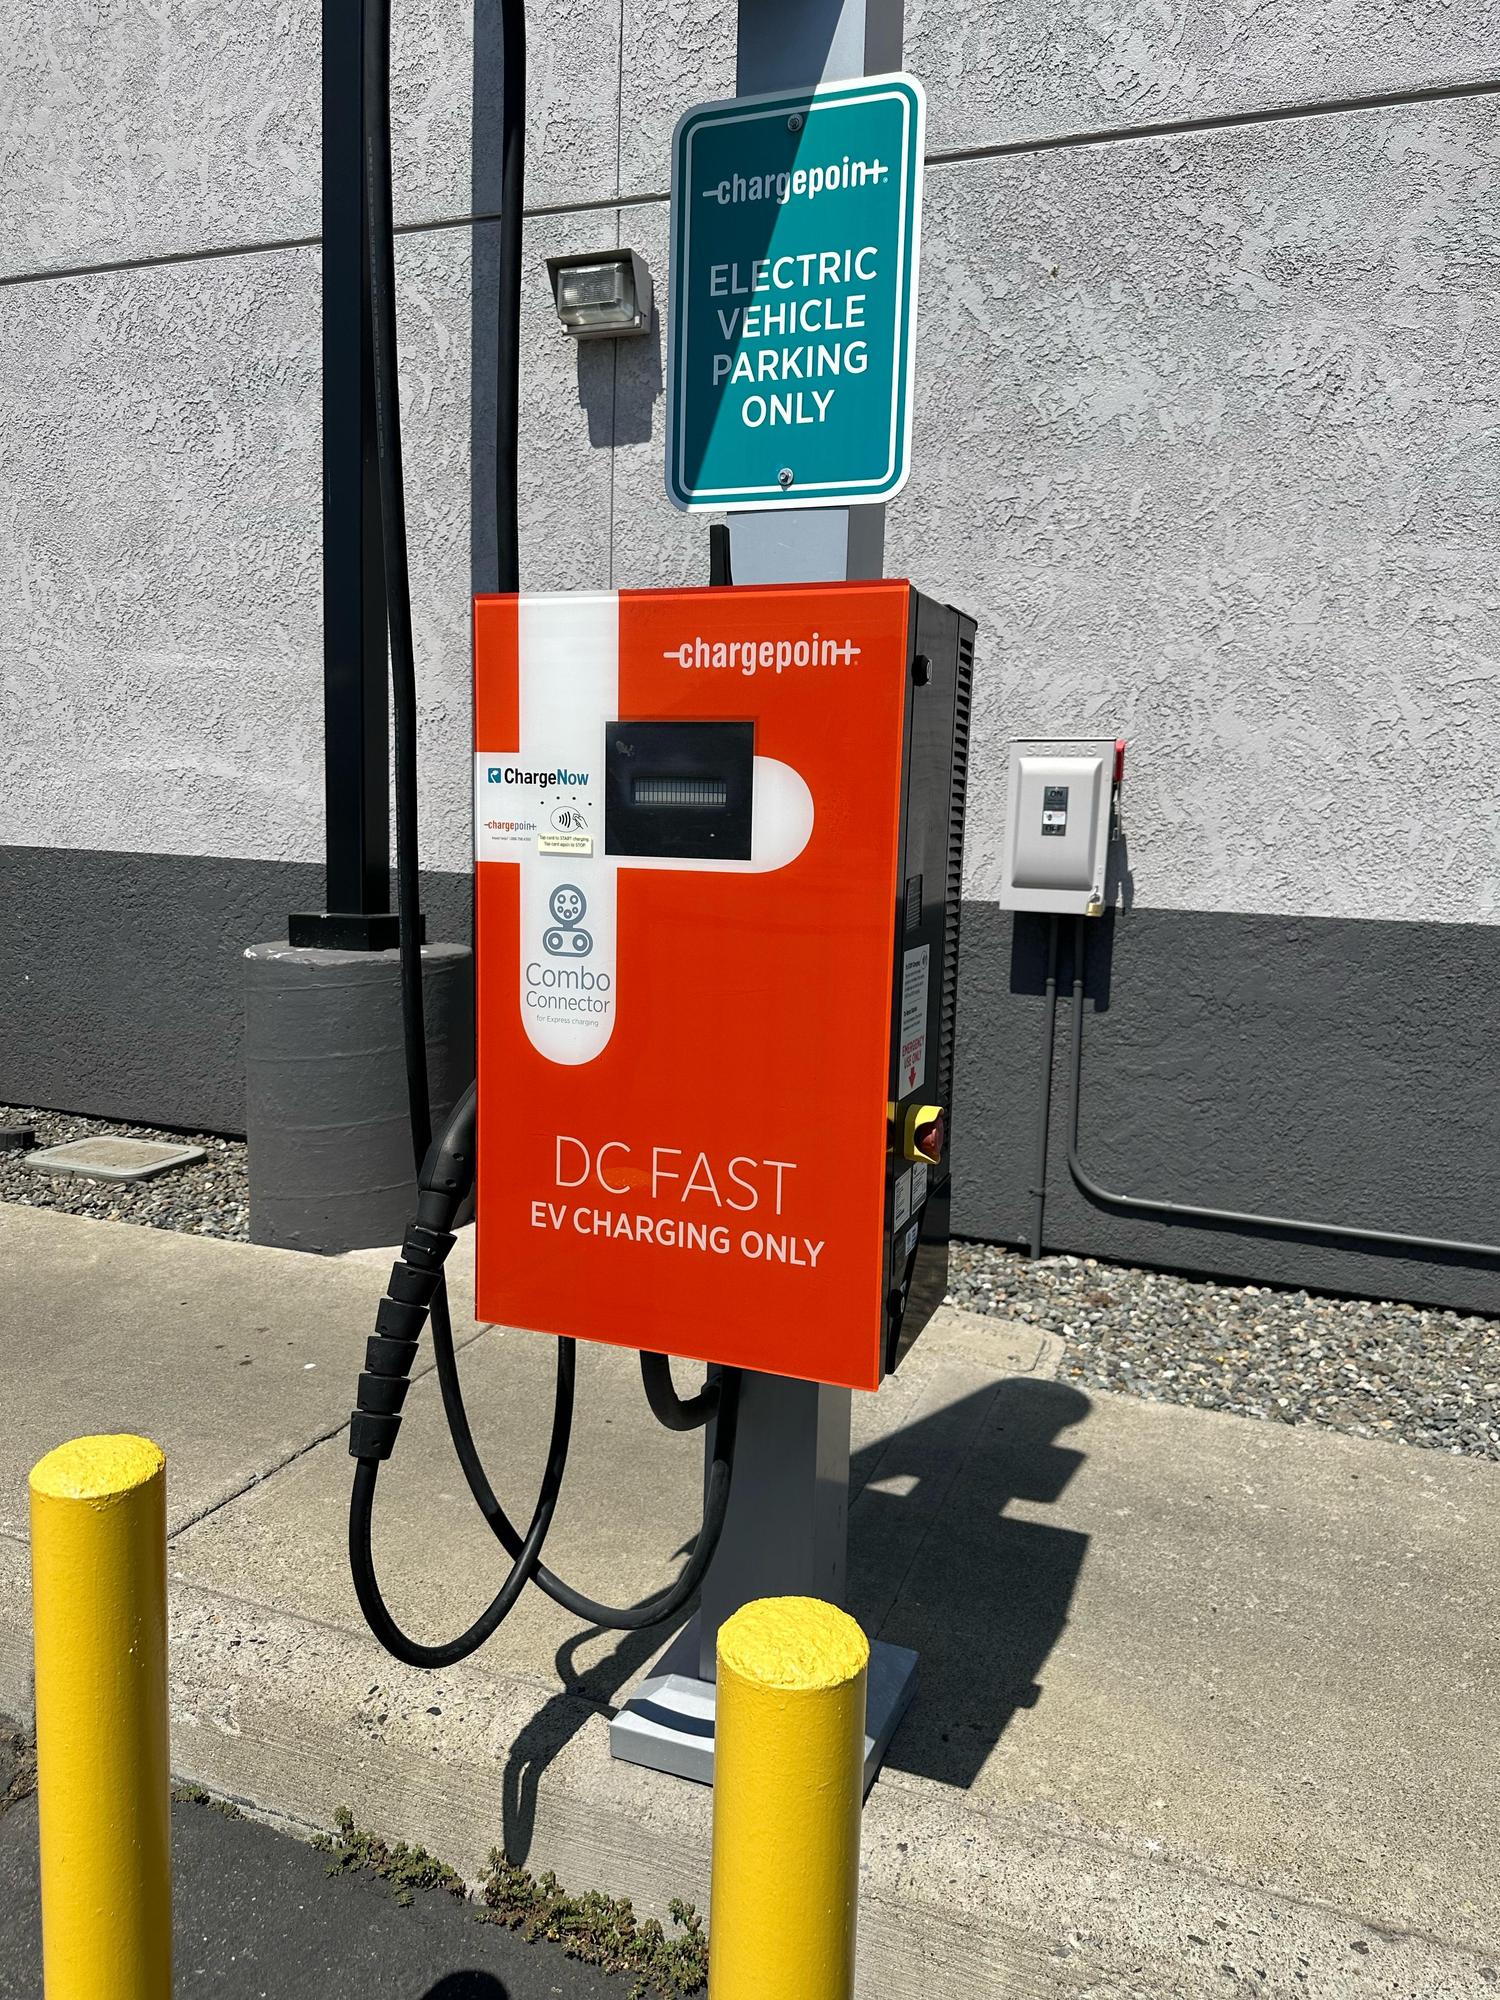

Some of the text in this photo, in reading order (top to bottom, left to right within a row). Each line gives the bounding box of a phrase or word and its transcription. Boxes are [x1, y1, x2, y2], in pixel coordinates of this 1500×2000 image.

[710, 246, 878, 296] ELECTRIC
[717, 295, 866, 340] VEHICLE
[712, 341, 868, 386] PARKING
[741, 390, 834, 428] ONLY
[504, 768, 589, 788] ChargeNow
[526, 962, 610, 991] Combo
[526, 990, 611, 1013] Connector
[547, 1016, 570, 1024] Express
[572, 1018, 599, 1027] charging
[555, 1135, 797, 1215] DC FAST
[531, 1201, 825, 1268] EV CHARGING ONLY
